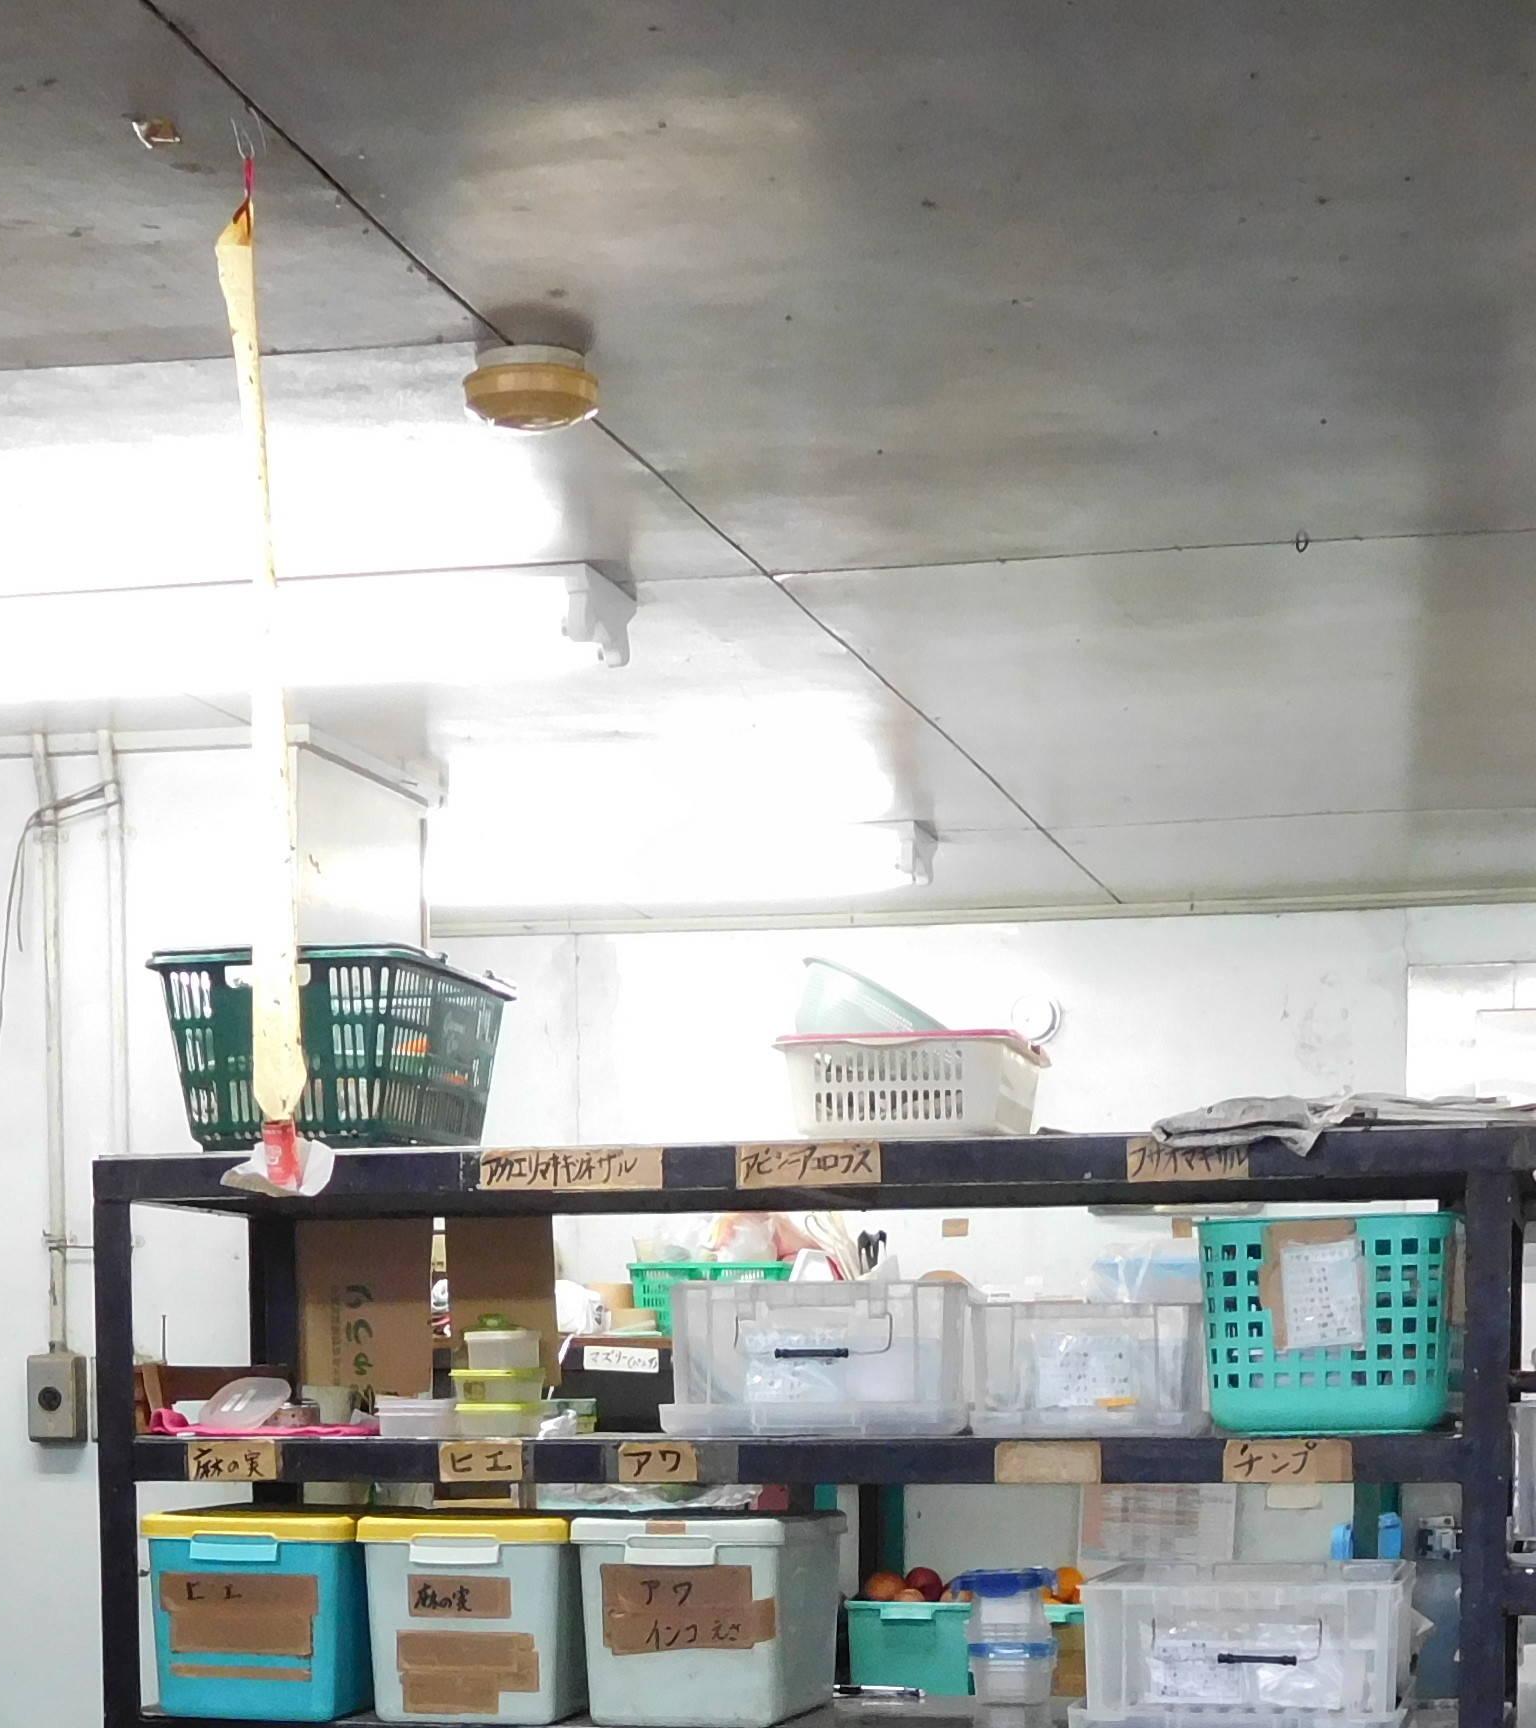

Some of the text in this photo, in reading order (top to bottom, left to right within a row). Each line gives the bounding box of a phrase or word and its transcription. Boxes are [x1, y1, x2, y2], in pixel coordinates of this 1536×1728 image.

[193, 1447, 265, 1480] 麻の実
[450, 1450, 512, 1473] ヒエ
[623, 1450, 681, 1477] アワ
[640, 1579, 693, 1606] アワ
